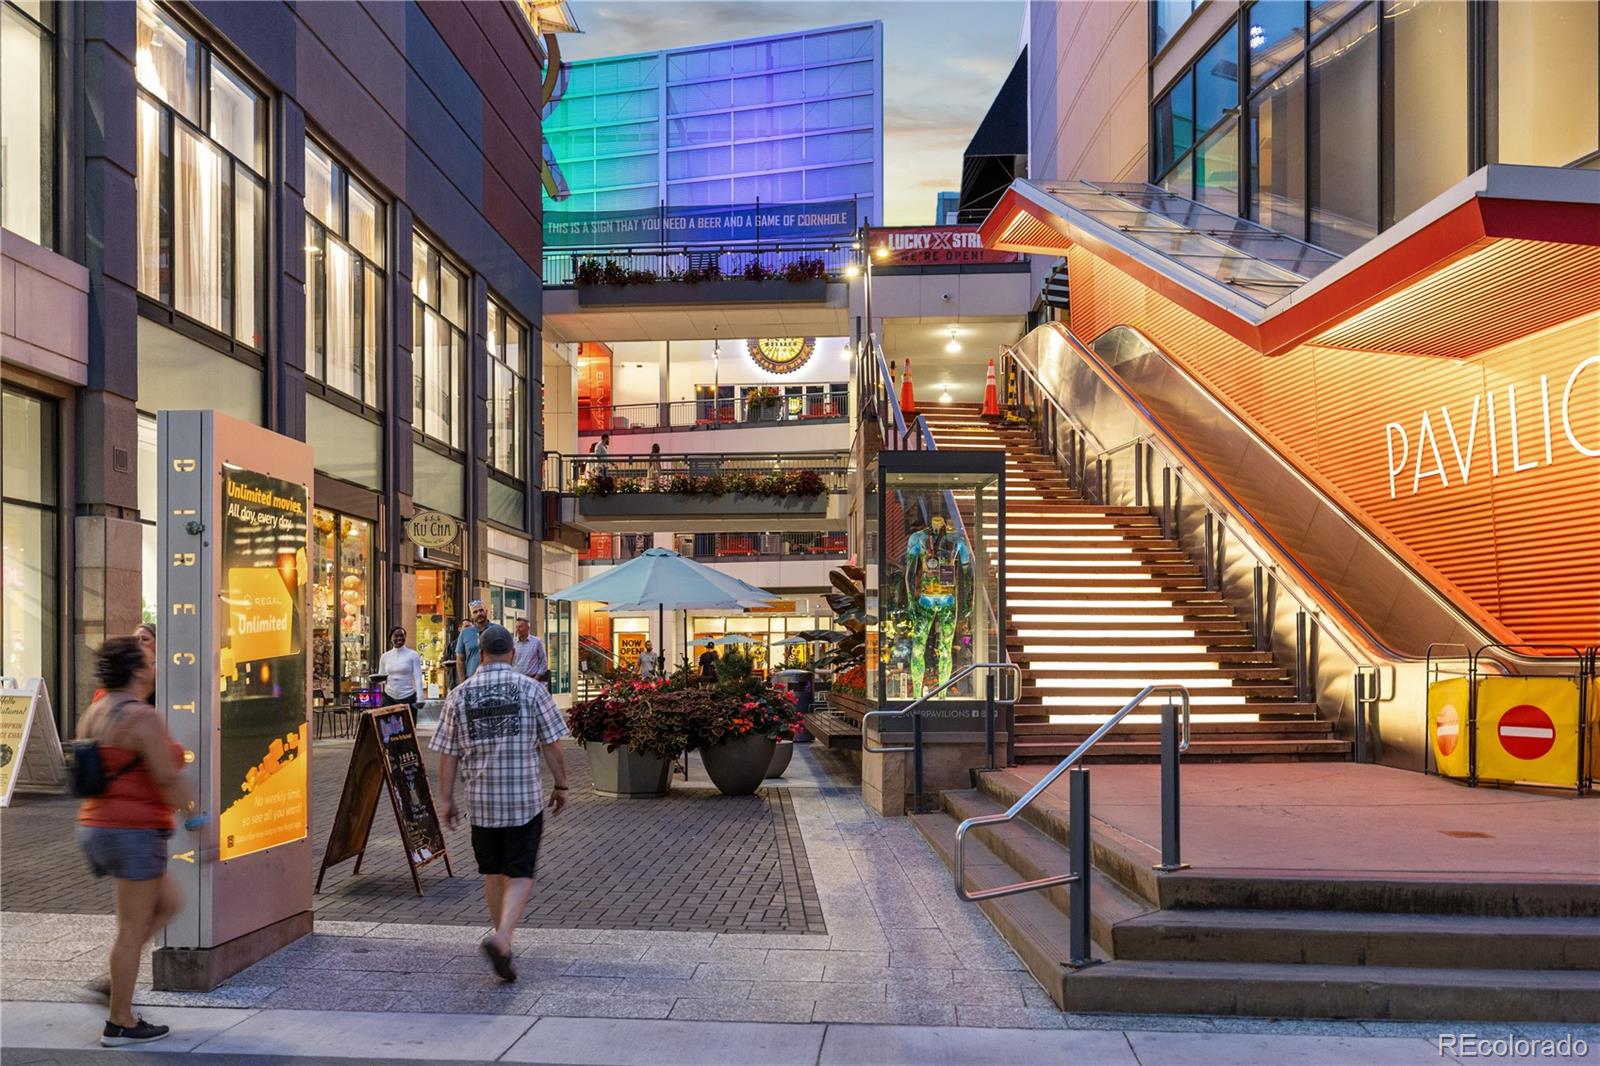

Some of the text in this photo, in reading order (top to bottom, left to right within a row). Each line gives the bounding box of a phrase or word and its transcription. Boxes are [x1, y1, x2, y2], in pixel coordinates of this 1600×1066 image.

[548, 212, 848, 234] THIS IS A SIGN THAT YOU NEED A BEER AND A GAME OF CORNHOLE
[888, 234, 931, 250] LUCKY
[952, 233, 984, 248] STRI
[901, 250, 984, 262] WE'RE OPEN!
[226, 480, 304, 514] Unlimited movies.
[228, 503, 240, 518] All
[240, 506, 256, 524] day,
[258, 512, 278, 528] every
[238, 614, 288, 634] Unlimited
[622, 640, 642, 648] NOW
[172, 459, 196, 863] DIRECTOY
